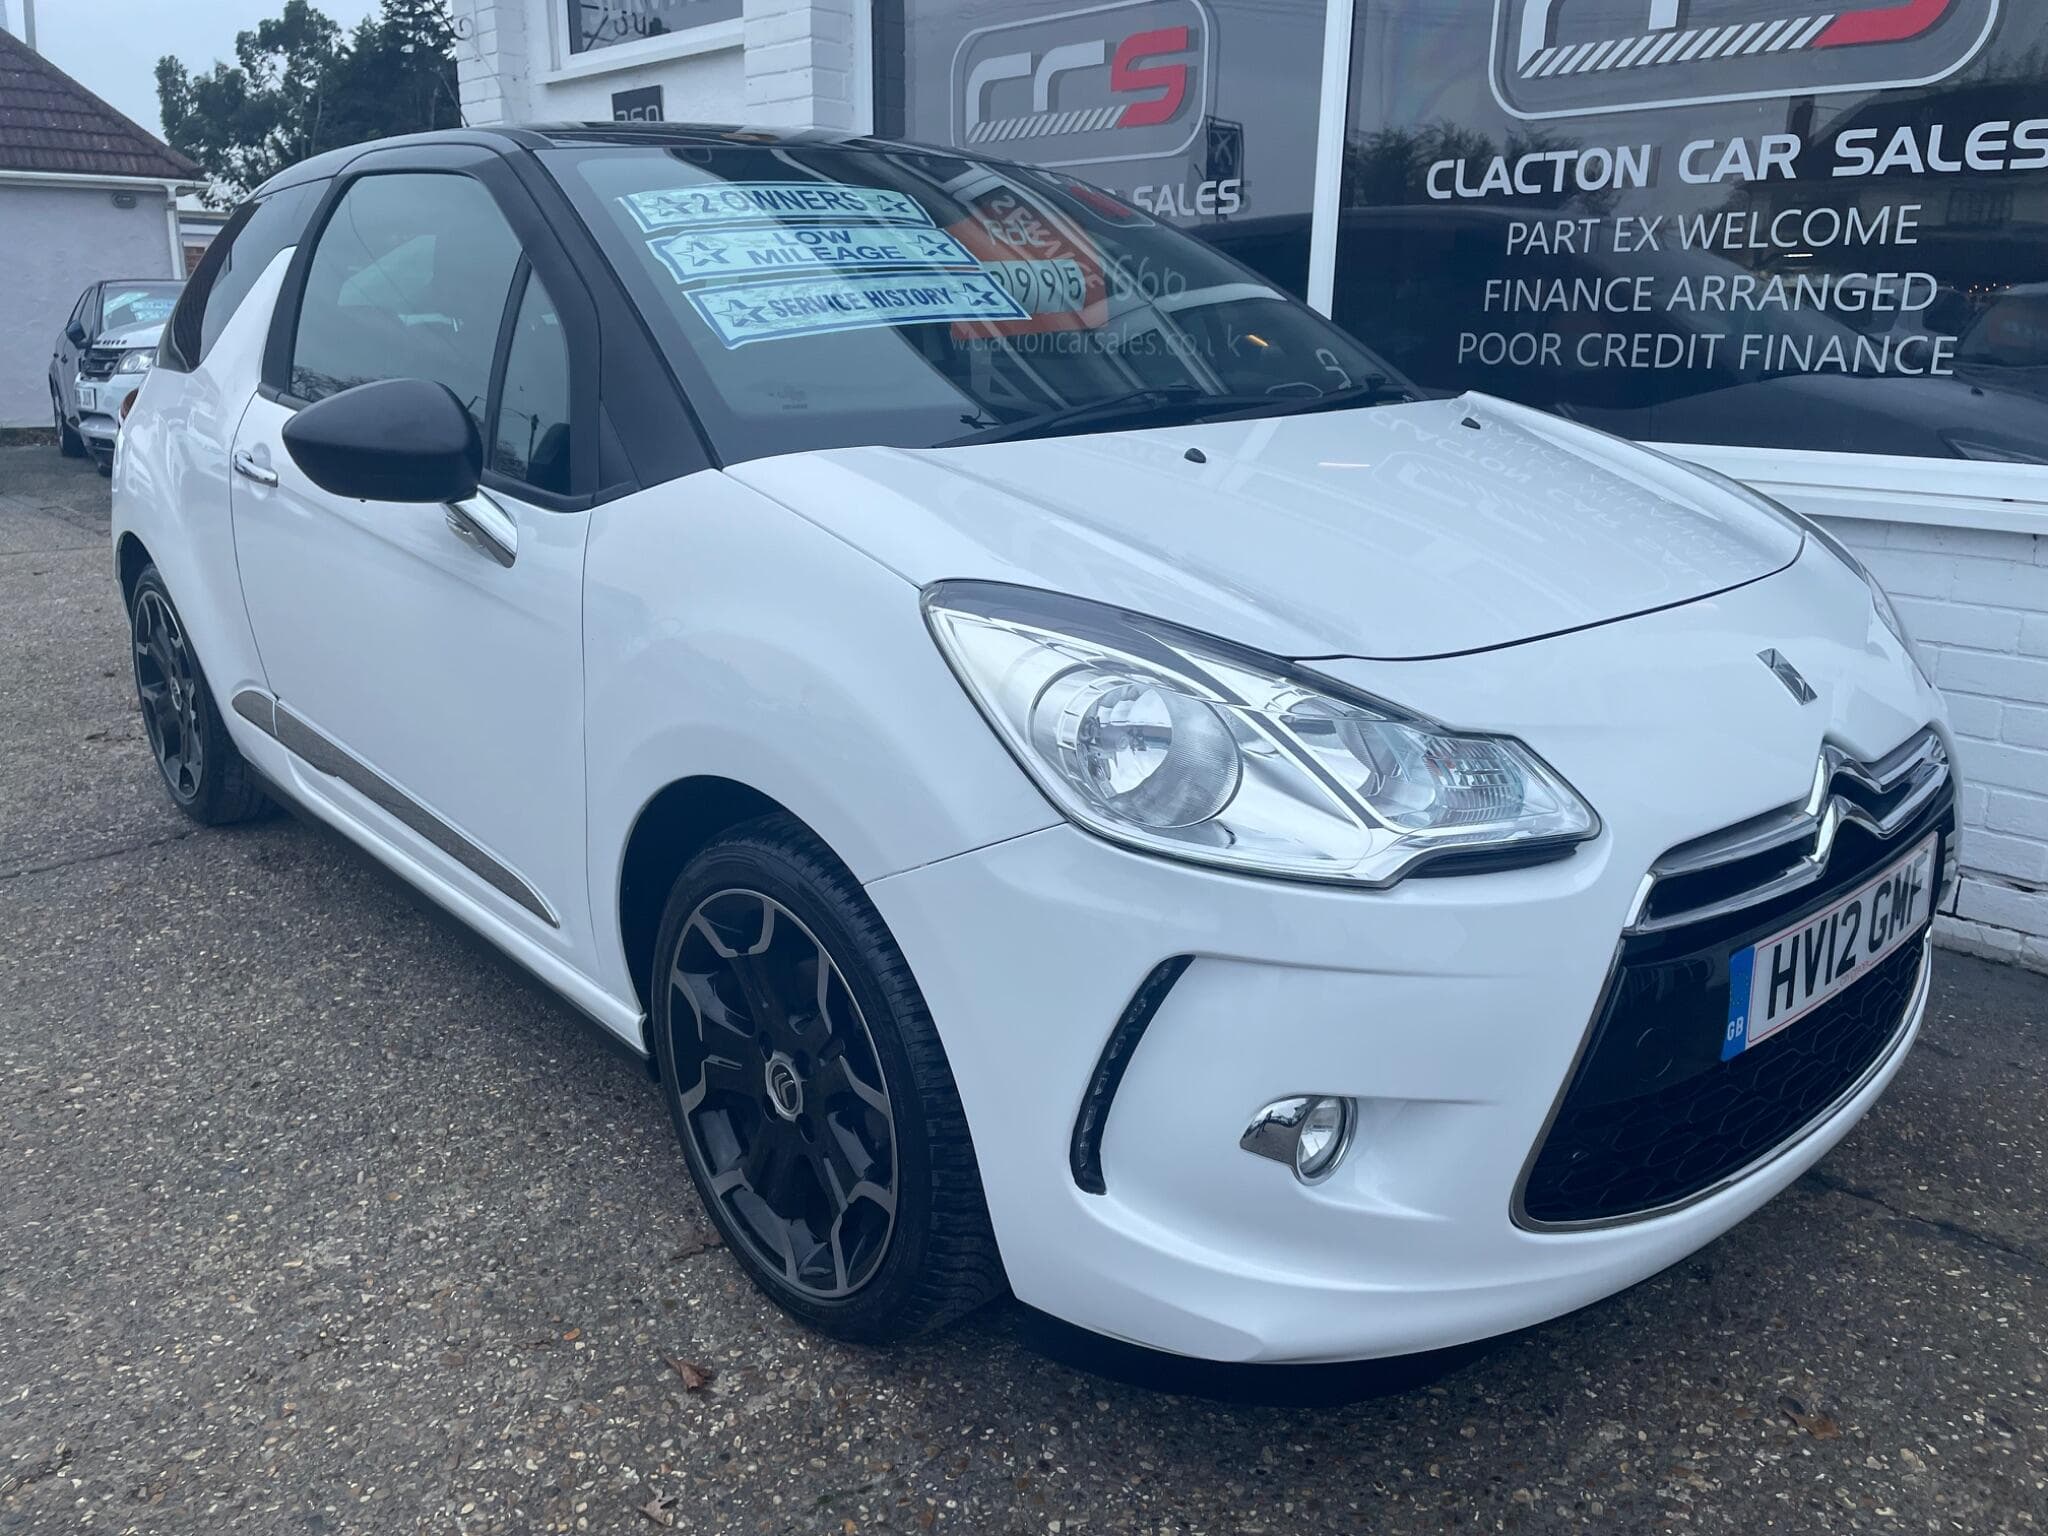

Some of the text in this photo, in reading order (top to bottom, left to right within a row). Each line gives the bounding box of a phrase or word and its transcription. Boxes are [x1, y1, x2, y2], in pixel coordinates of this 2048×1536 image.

[1426, 118, 2048, 200] CLACTON CAR SALES
[694, 189, 866, 214] 2 OWNERS
[1133, 178, 1241, 218] SALES
[774, 229, 851, 246] LOW
[1506, 204, 1922, 257] PART EX WELCOME
[747, 245, 907, 265] MILEAGE
[767, 287, 954, 318] SERVICE HISTORY
[1484, 271, 1939, 314] FINANCE ARRANGED
[1458, 332, 1958, 376] POOR CREDIT FINANCE
[1767, 900, 1862, 1021] HV12
[1726, 1016, 1745, 1041] GB
